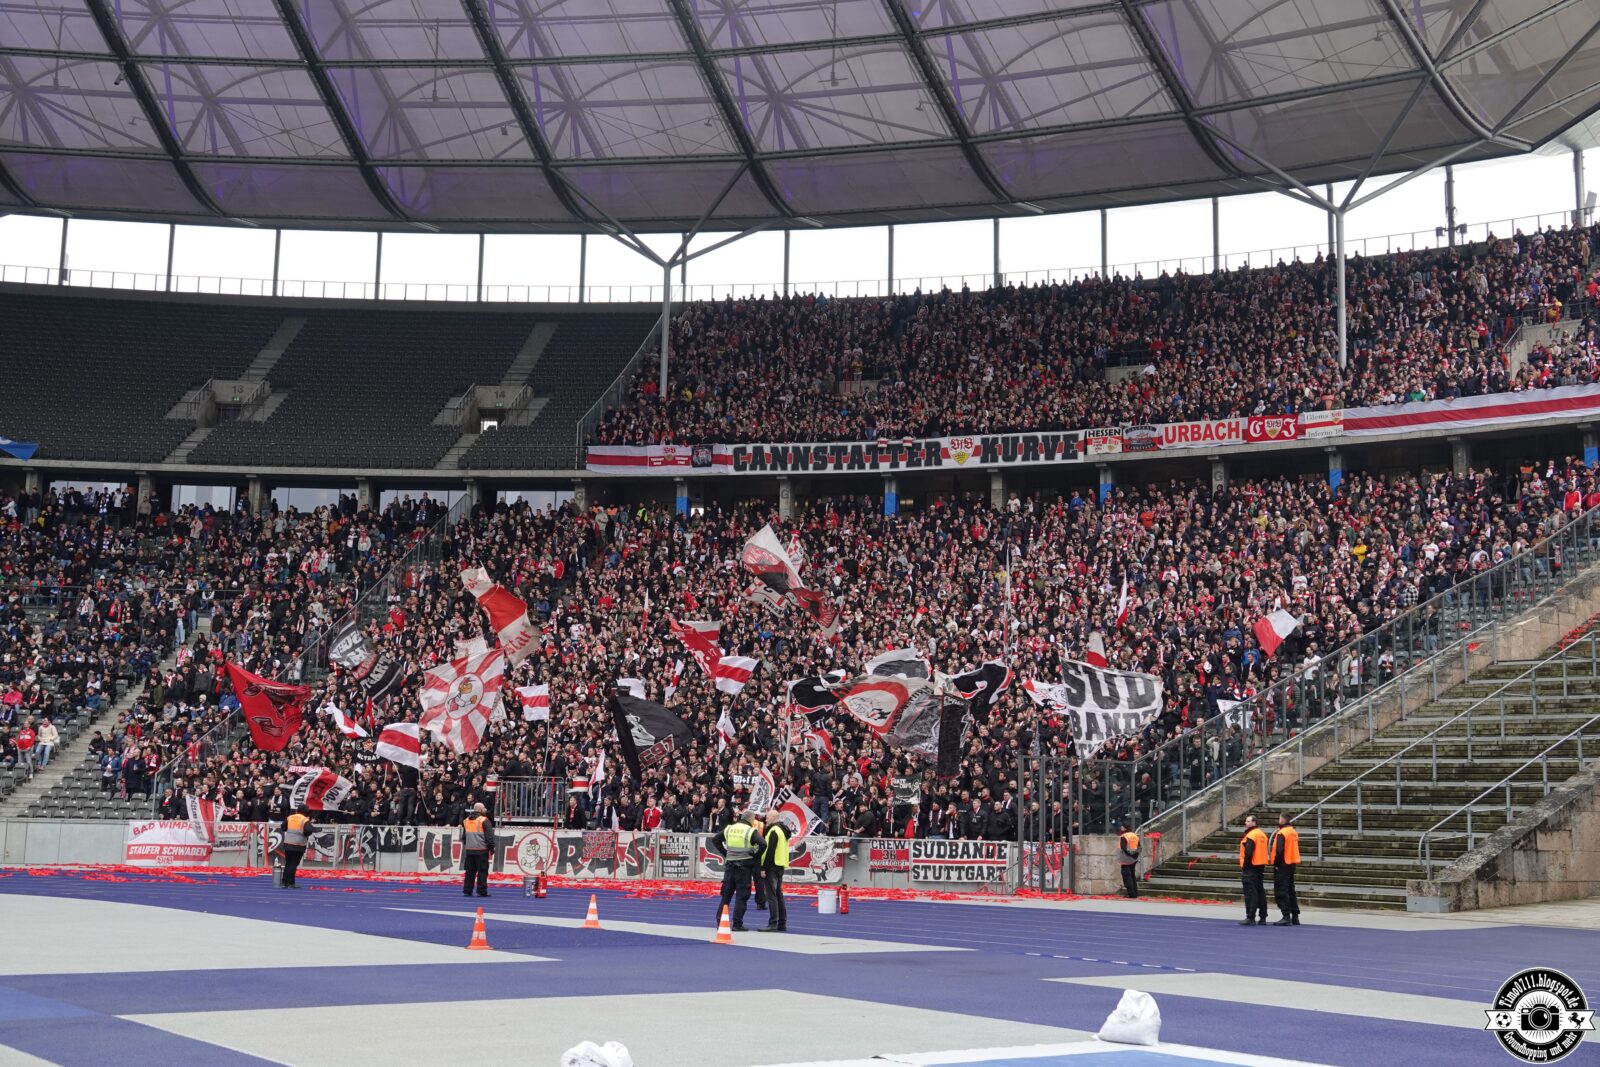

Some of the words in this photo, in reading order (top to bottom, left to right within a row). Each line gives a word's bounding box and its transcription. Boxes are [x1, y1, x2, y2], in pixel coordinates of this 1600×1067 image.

[1088, 429, 1120, 438] HESSEN
[1164, 418, 1240, 444] URBACH
[733, 440, 942, 472] CANNSTATTER
[981, 434, 1079, 463] KURVE
[133, 822, 154, 836] BAD
[128, 846, 160, 855] STAUFER
[162, 846, 207, 856] SCHWABEN
[872, 840, 906, 849] CREW
[420, 832, 650, 876] UTRS
[882, 850, 896, 860] 36
[912, 865, 1006, 880] STUTTGART
